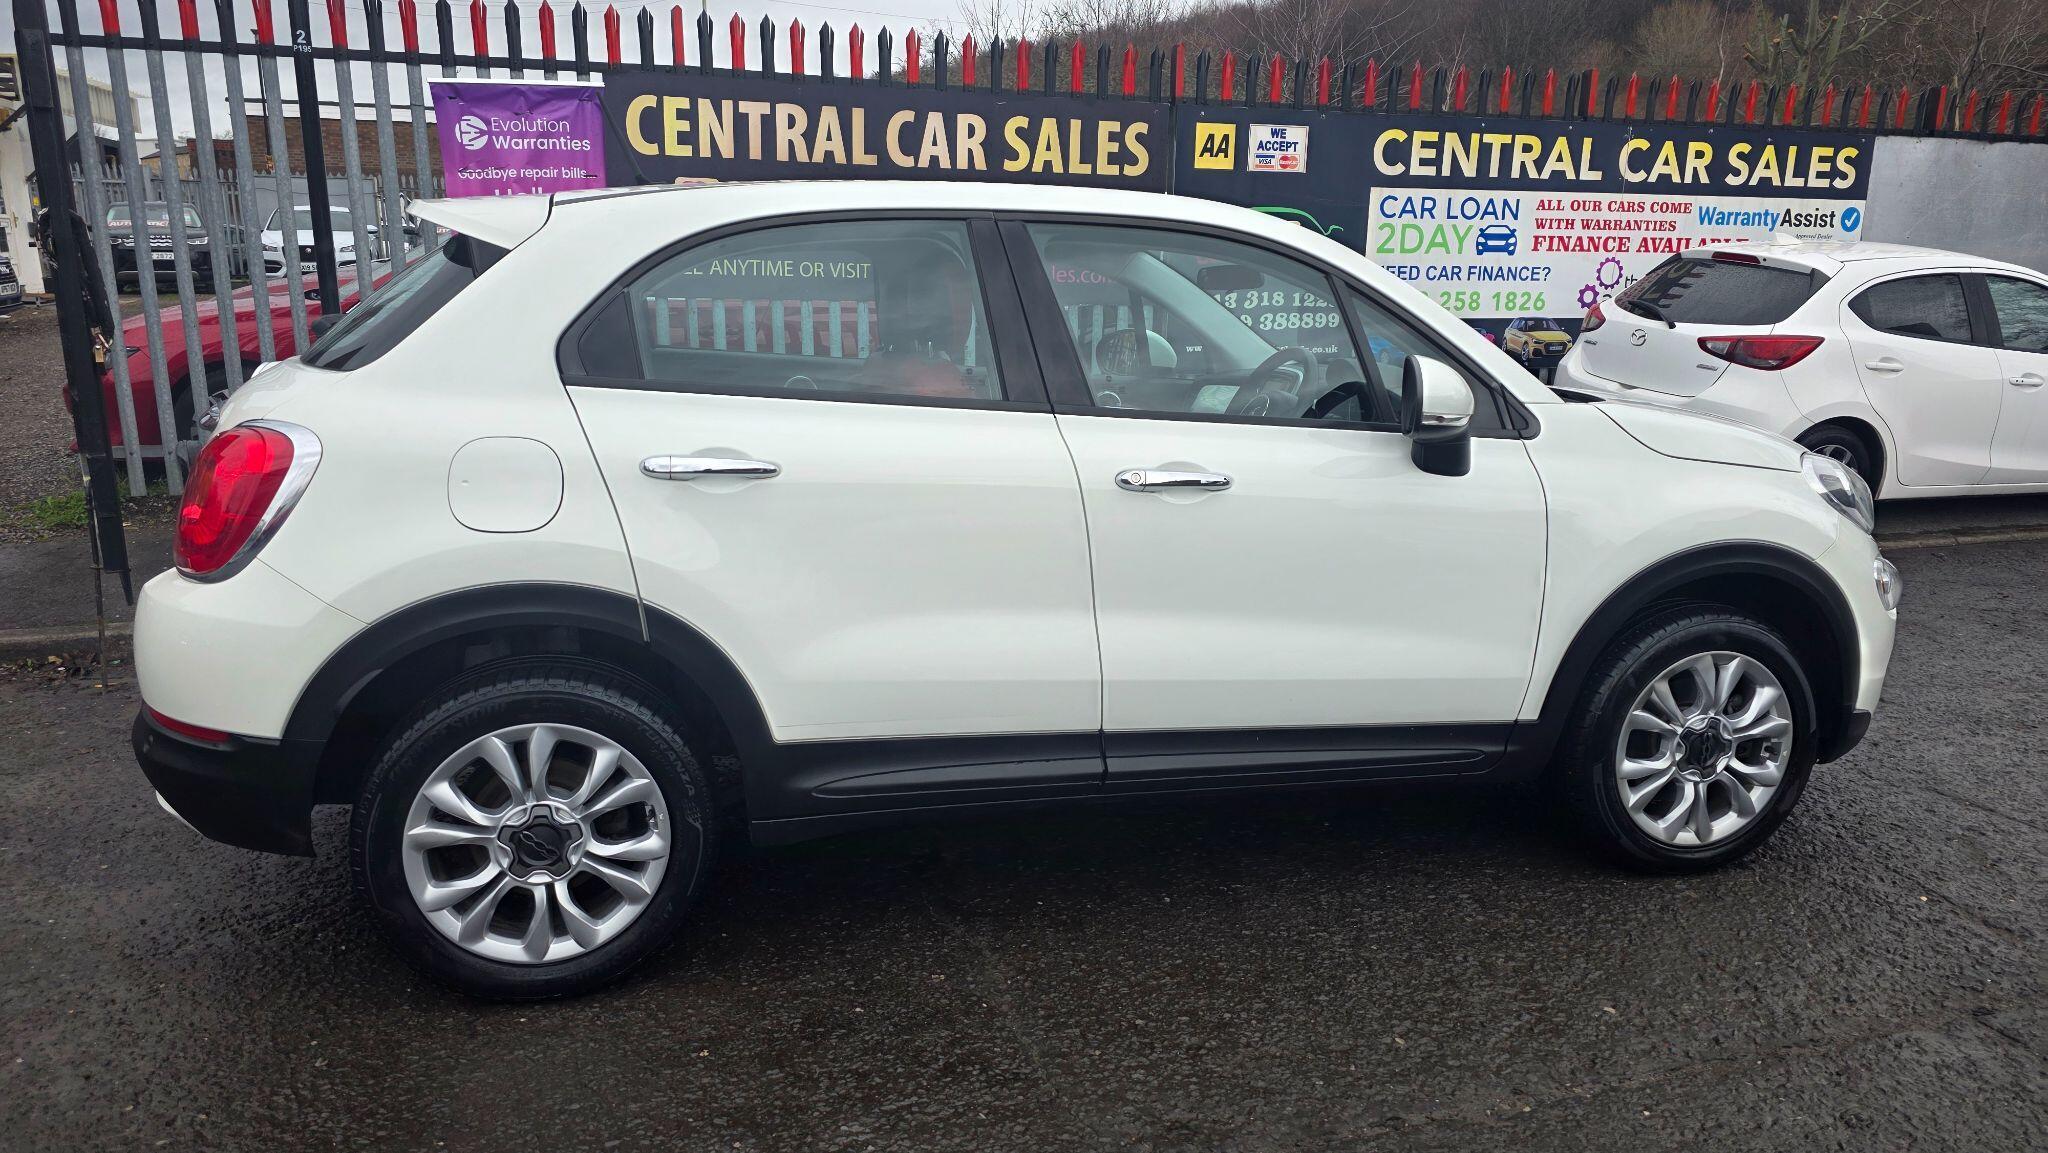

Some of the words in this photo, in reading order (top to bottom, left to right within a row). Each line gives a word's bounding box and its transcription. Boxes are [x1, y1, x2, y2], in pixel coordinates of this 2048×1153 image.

[296, 30, 306, 44] 2
[492, 117, 570, 133] Evolution
[625, 94, 878, 166] CENTRAL
[886, 109, 988, 171] CAR
[1004, 116, 1150, 177] SALES
[1271, 128, 1287, 139] WE
[494, 136, 591, 152] Warranties
[1199, 134, 1230, 158] AA
[1257, 140, 1298, 152] ACCEPT
[1373, 128, 1603, 181] CENTRAL
[1619, 137, 1713, 184] CAR
[1725, 142, 1860, 189] SALES
[458, 167, 517, 181] Goodbye
[520, 167, 558, 180] repair
[1380, 194, 1437, 219] CAR
[1446, 196, 1520, 221] LOAN
[1536, 200, 1565, 211] ALL
[1570, 200, 1602, 212] OUR
[1608, 201, 1646, 213] CARS
[1650, 202, 1692, 214] COME
[1535, 218, 1575, 230] WITH
[1581, 219, 1677, 232] WARRANTIES
[1376, 222, 1474, 254] 2DAY
[1532, 236, 1630, 252] FINANCE
[710, 259, 794, 277] ANYTIME
[800, 262, 824, 278] OR
[830, 262, 871, 278] VISIT
[1426, 266, 1461, 280] CAR
[1467, 266, 1551, 281] FINANCE?
[1244, 291, 1284, 309] 318
[1292, 292, 1335, 308] 122
[1440, 290, 1480, 311] 258
[1492, 291, 1546, 311] 1826
[1260, 312, 1340, 330] 388899
